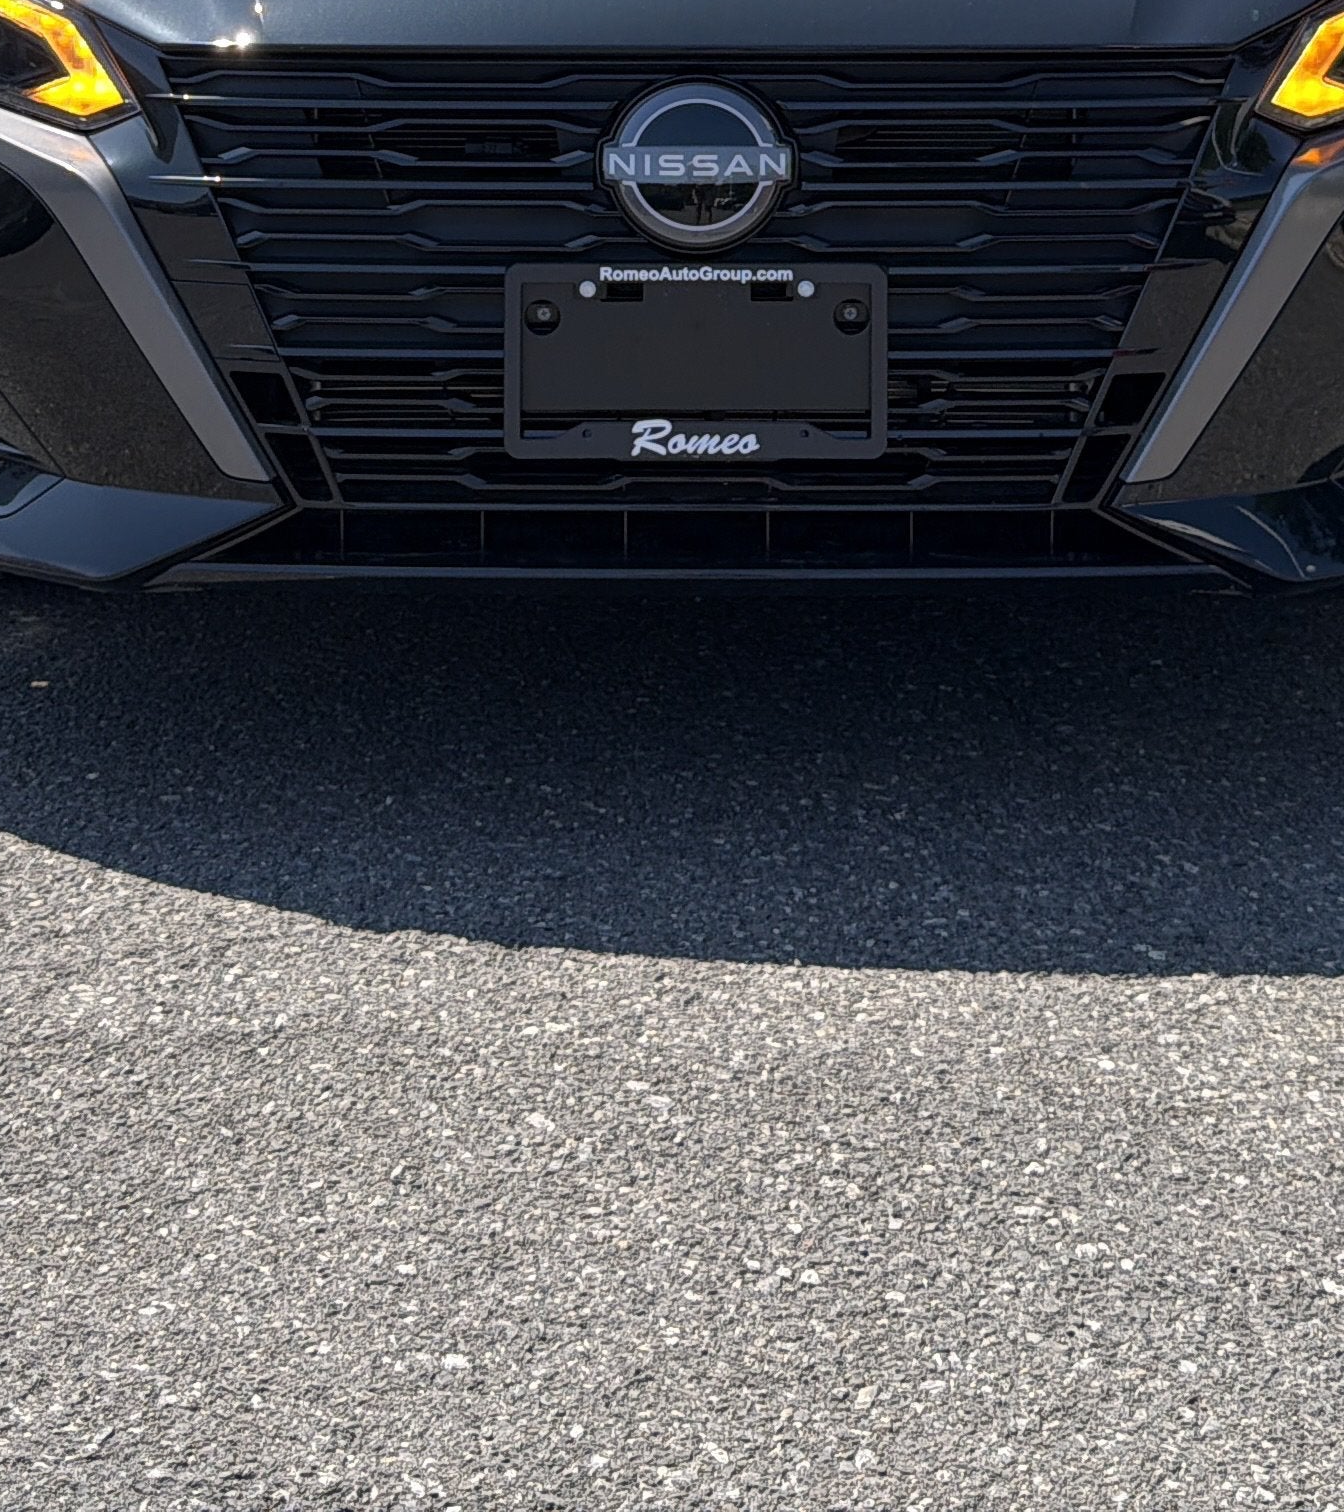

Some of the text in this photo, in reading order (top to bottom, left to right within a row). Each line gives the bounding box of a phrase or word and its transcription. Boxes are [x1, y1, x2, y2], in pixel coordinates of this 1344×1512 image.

[607, 153, 788, 178] NISSAN
[599, 266, 794, 284] RomeoAutoGroup.com
[630, 418, 761, 458] Romeo
